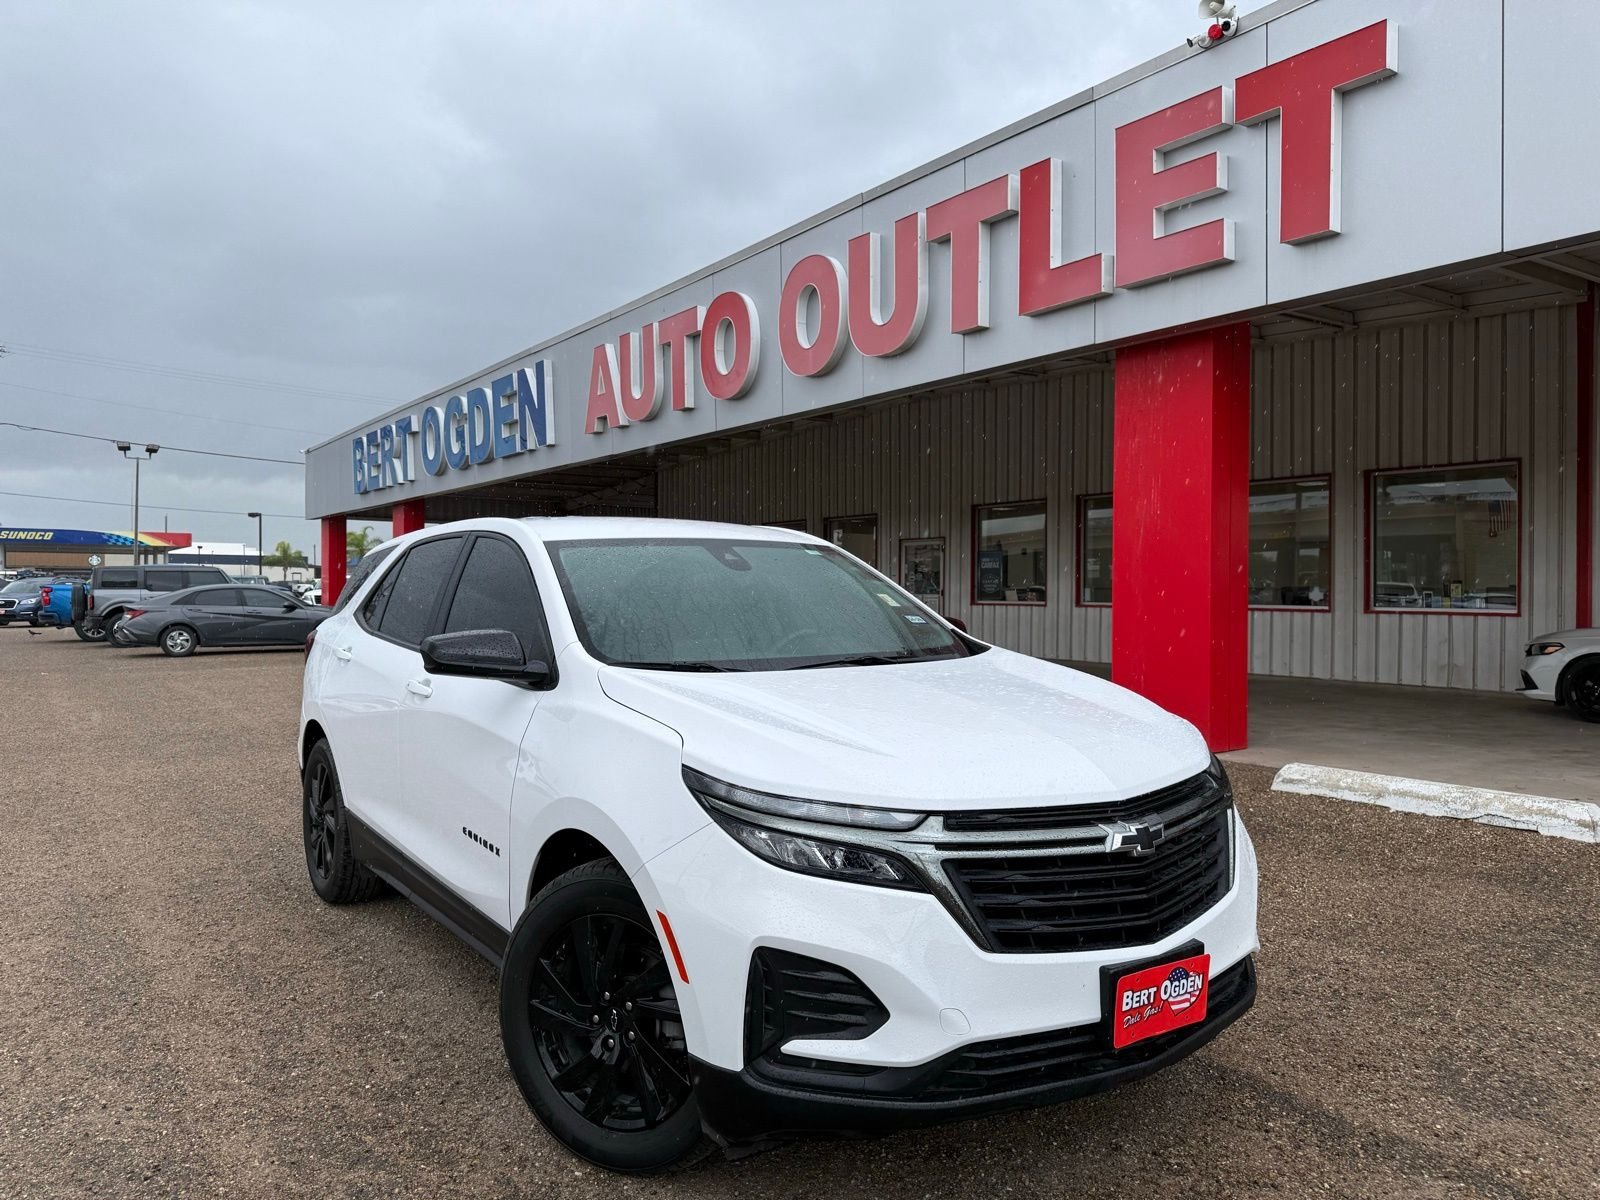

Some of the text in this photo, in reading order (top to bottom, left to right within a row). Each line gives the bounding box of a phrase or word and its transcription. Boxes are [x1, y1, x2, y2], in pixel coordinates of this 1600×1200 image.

[353, 18, 1399, 495] BERT OGDEN AUTO OUTLET
[0, 530, 54, 540] SUNOCO
[1122, 974, 1203, 1012] BERT OGDEN
